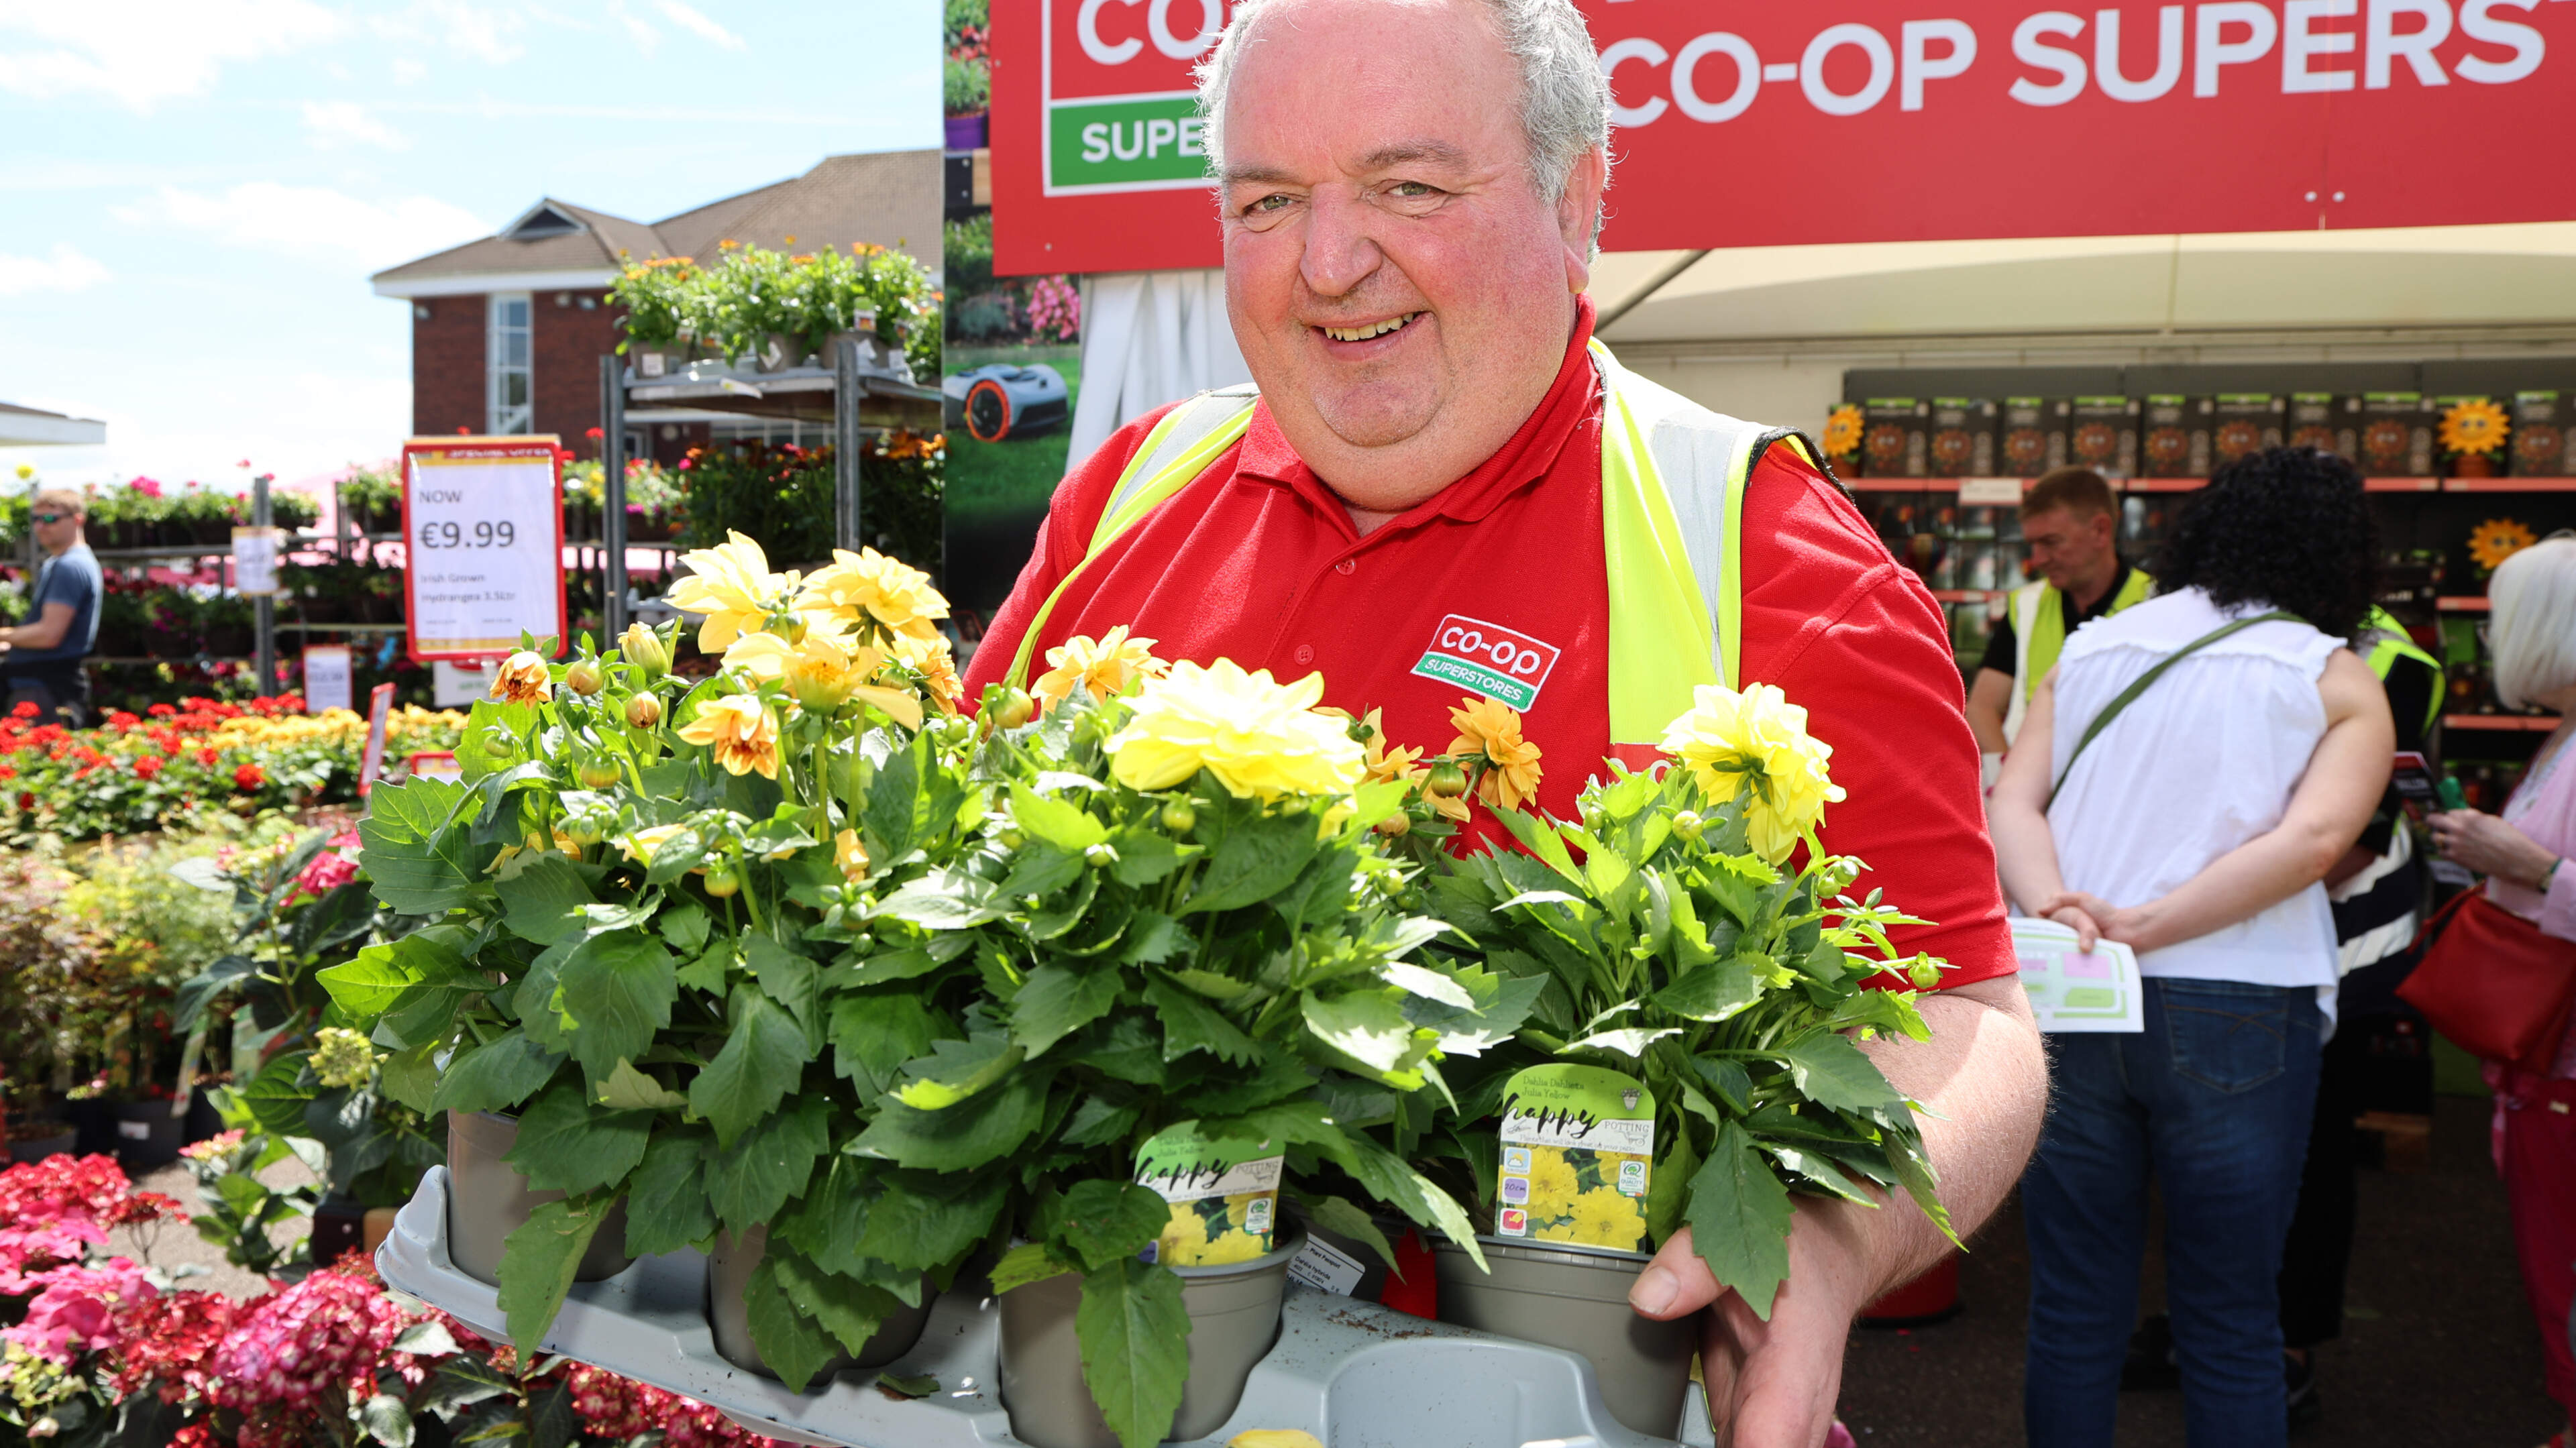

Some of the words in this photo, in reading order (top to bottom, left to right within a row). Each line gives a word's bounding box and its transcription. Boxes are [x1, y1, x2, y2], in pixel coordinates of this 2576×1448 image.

[1077, 0, 1236, 65] CO
[1599, 17, 1977, 128] CO-OP
[2008, 0, 2546, 107] SUPERS
[1082, 118, 1205, 163] SUPE
[419, 490, 462, 503] NOW
[420, 520, 515, 549] €9.99
[421, 573, 444, 583] Irish
[447, 573, 486, 583] Grown
[421, 592, 480, 603] Hydrangea
[1424, 658, 1523, 701] SUPERSTORES
[1523, 1075, 1548, 1086] Dahlia
[1521, 1087, 1542, 1097] Julia
[1544, 1089, 1570, 1099] Yellow
[1502, 1093, 1601, 1139] happy
[1604, 1120, 1650, 1133] POTTING
[1136, 1156, 1229, 1191] happy
[1236, 1161, 1279, 1173] POTTING
